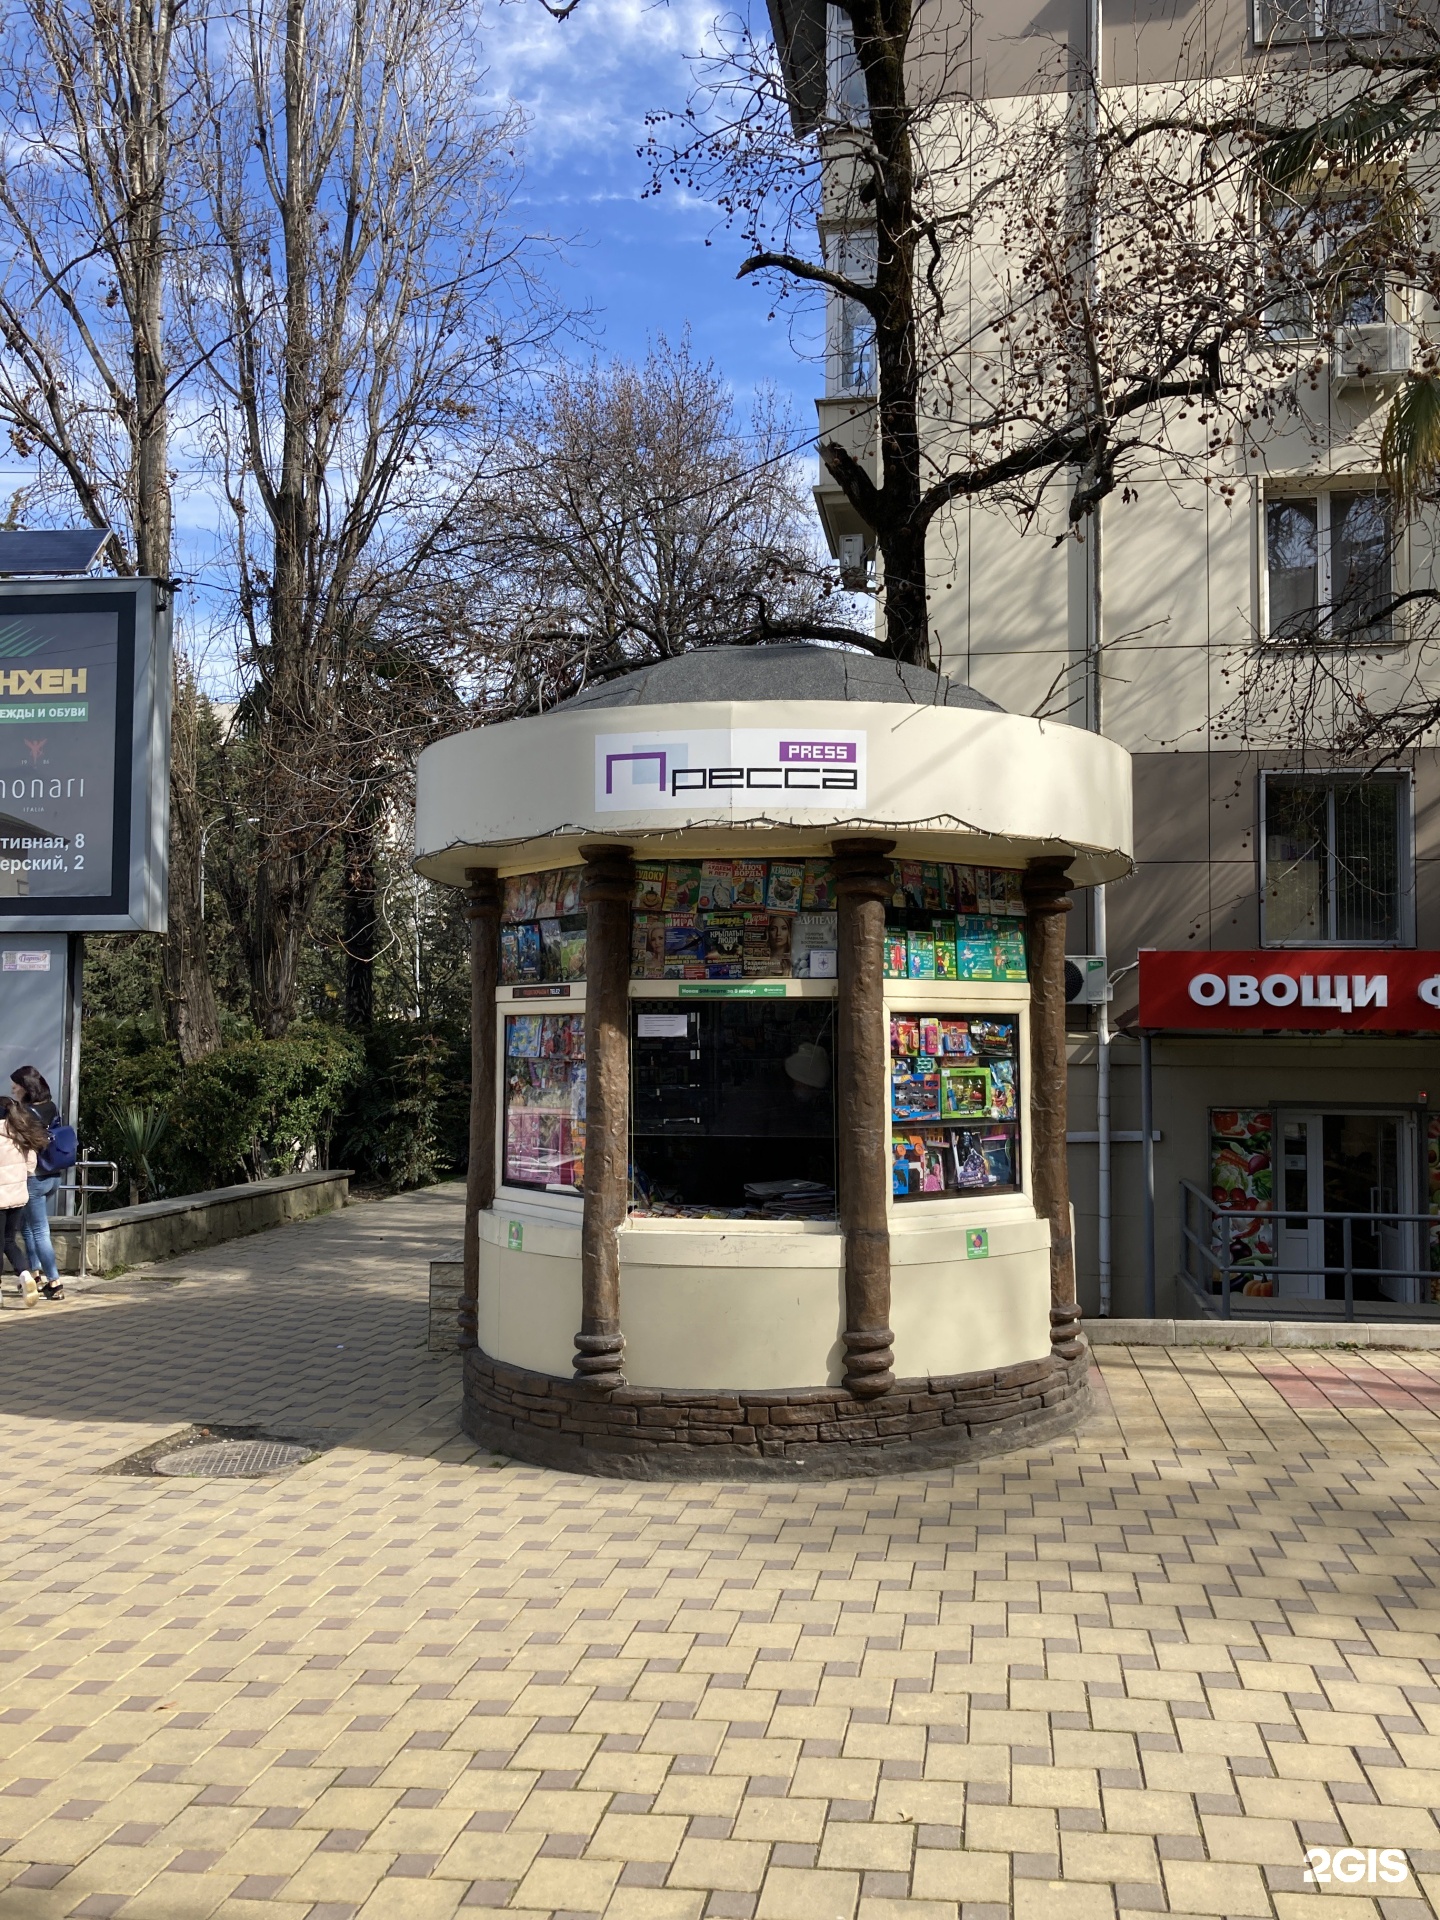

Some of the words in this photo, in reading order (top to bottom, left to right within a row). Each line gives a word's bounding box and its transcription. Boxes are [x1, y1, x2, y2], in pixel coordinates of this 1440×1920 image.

[0, 668, 87, 695] НХЕН
[38, 708, 46, 718] И
[49, 707, 86, 718] ОБУВИ
[788, 744, 848, 760] PRESS
[0, 837, 70, 852] тивная,
[75, 833, 85, 849] 8
[0, 855, 68, 874] ерский,
[74, 855, 84, 870] 2
[734, 870, 764, 878] ВОРДЫ
[1188, 973, 1388, 1013] ОВОЩИ
